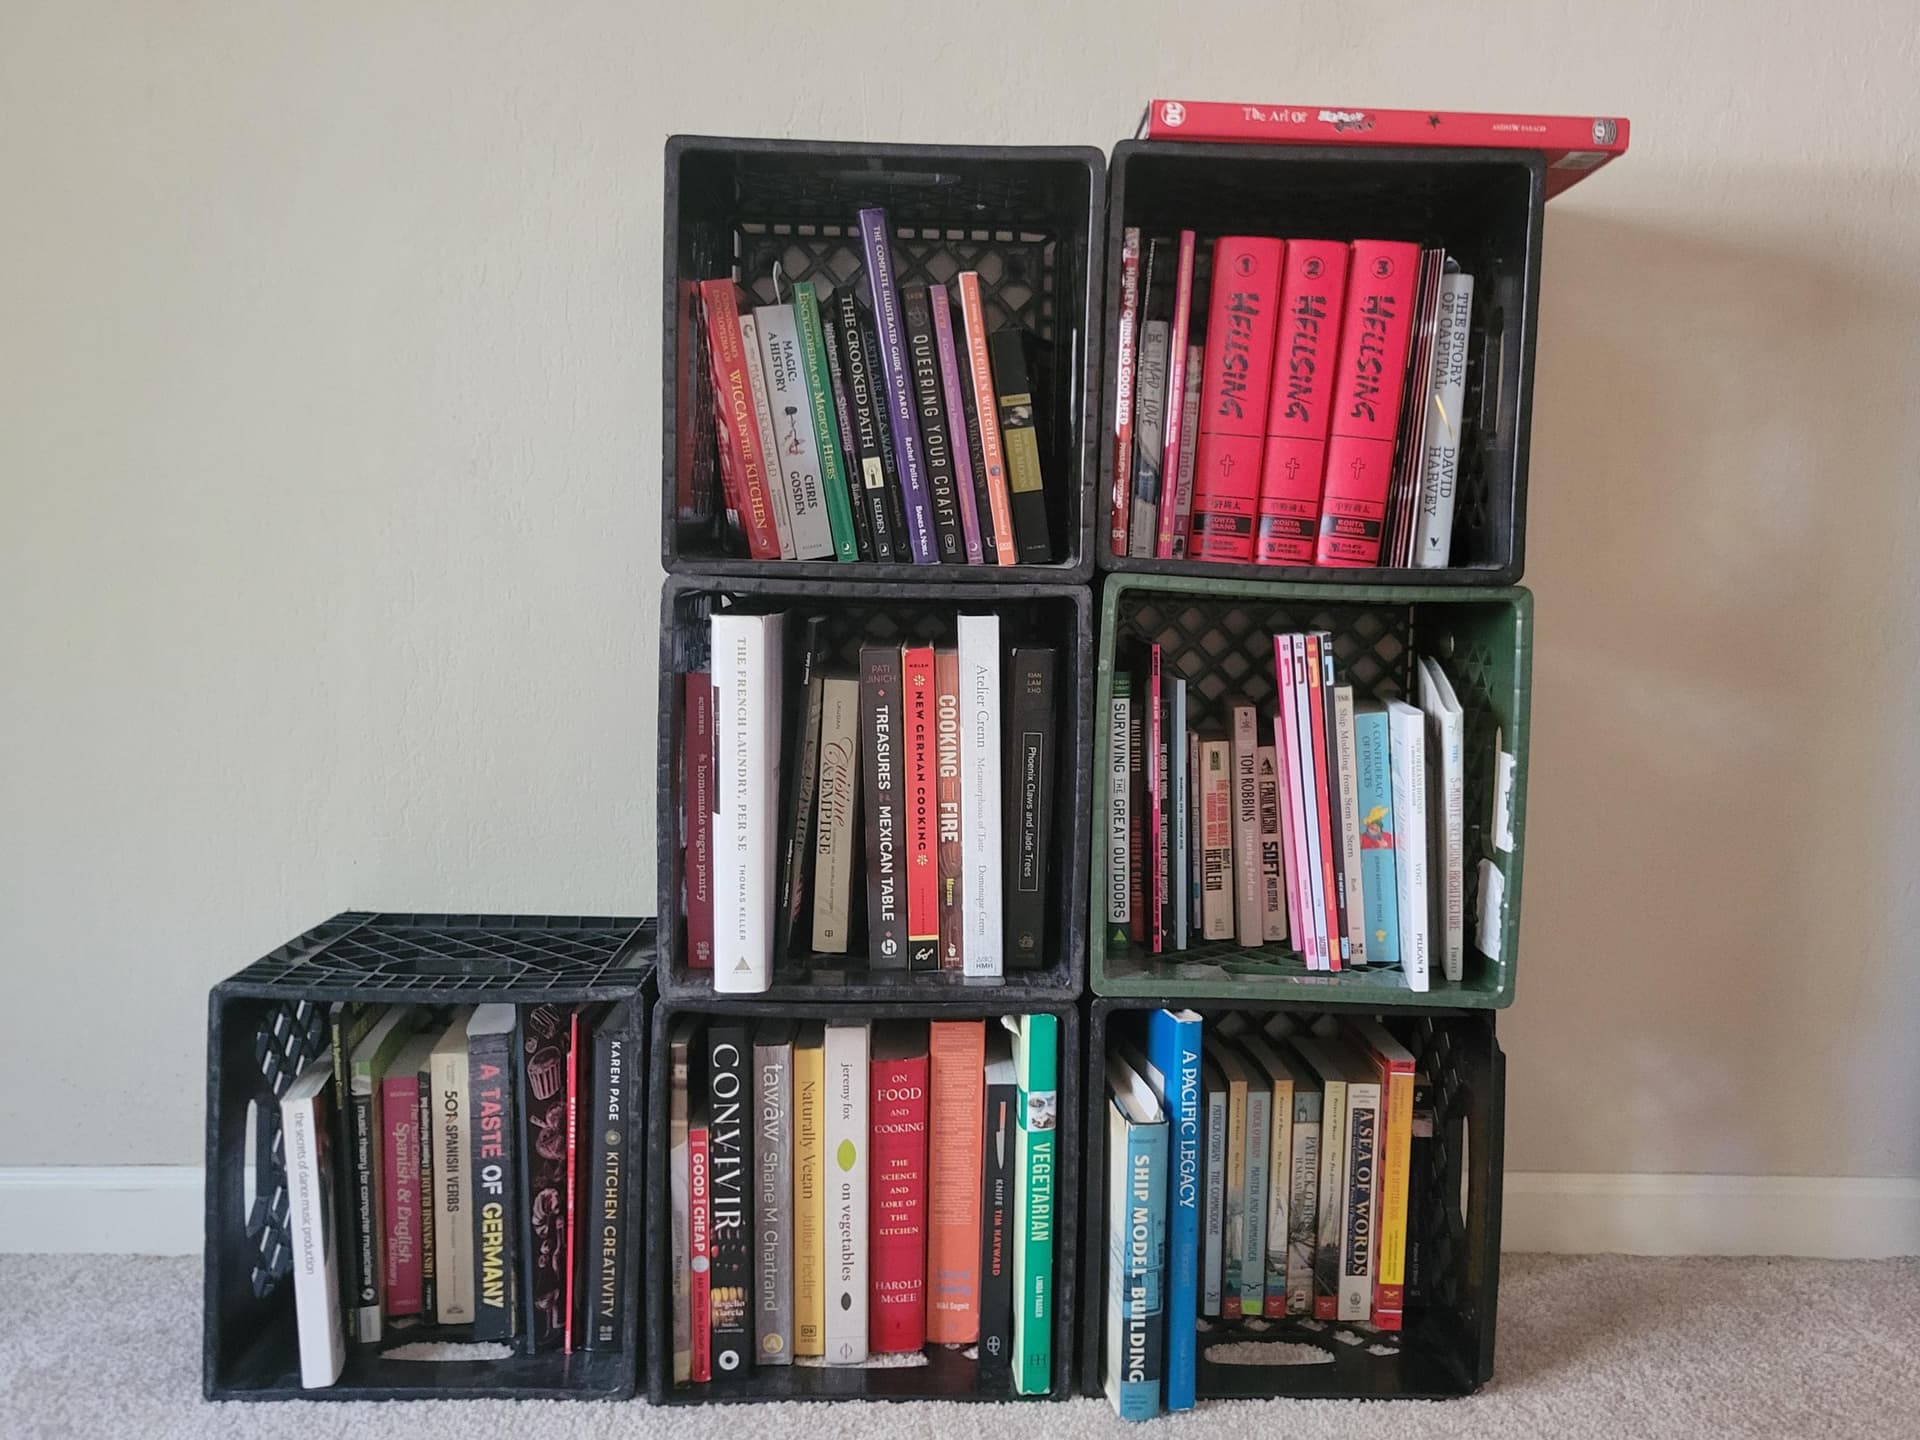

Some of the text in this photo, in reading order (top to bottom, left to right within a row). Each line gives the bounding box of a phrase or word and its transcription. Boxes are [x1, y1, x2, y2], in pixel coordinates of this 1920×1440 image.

[1124, 267, 1136, 308] HARLEY
[1306, 259, 1320, 276] 2
[1376, 259, 1388, 276] 3
[872, 225, 910, 420] THE COMPLETE ILLUSTRATED GUIDE TO TAROT
[1434, 291, 1454, 390] OF CAPITAL
[1450, 293, 1469, 388] THE STORY
[768, 331, 787, 393] A HISTORY
[782, 341, 798, 383] MAGIC:
[841, 293, 876, 449] THE CROOKED PATH
[912, 334, 939, 417] QUEERING
[1121, 349, 1132, 365] NO
[1121, 367, 1131, 398] GOOD
[1219, 293, 1260, 420] HELLSING
[1284, 296, 1327, 424] HELLSING
[1351, 296, 1396, 423] HELLSING
[1120, 399, 1130, 425] DEED
[1142, 360, 1162, 432] MAD LOVE
[729, 368, 767, 530] WICCA IN THE KITCHEN
[927, 424, 948, 468] YOUR
[1184, 401, 1197, 447] Bloom
[1179, 451, 1193, 478] Into
[1425, 446, 1440, 517] HARVEY
[1440, 447, 1456, 499] DAVID
[790, 470, 805, 516] GOSDEN
[804, 473, 817, 509] CHRIS
[873, 497, 886, 534] KELDEN
[933, 475, 955, 526] CRAFT
[1178, 481, 1191, 506] You
[865, 673, 897, 683] JINICH
[871, 663, 890, 673] PATI
[735, 637, 749, 852] THE FRENCH LAUNDRY, PER SE
[915, 690, 927, 851] NEW GERMAN COOKING
[939, 693, 959, 843] COOKING FIRE
[1131, 720, 1141, 772] WALTER TEVIS
[1362, 736, 1374, 788] OF DUNCES
[1373, 721, 1384, 799] A CONFEDERACY
[1240, 752, 1256, 823] TOM ROBBINS
[1338, 707, 1356, 858] Ship Modeling from Stem to Stern
[695, 764, 708, 903] homemade vegan pantry
[875, 704, 895, 921] TREASURES MEXICAN TABLE
[1023, 746, 1037, 877] Phoenix Claws and Jade Trees
[1112, 703, 1126, 919] SURVIVING THE GREAT OUTDOORS
[1204, 848, 1223, 892] HEINLEIN
[738, 864, 747, 941] THOMAS KELLER
[444, 1089, 459, 1120] 501
[609, 1041, 621, 1121] KAREN PAGE
[842, 1062, 854, 1121] jeremy fox
[877, 1087, 922, 1102] FOOD
[891, 1074, 908, 1083] ON
[711, 1043, 742, 1231] CONVIVIR
[874, 1121, 925, 1134] COOKING
[890, 1107, 910, 1116] AND
[1177, 1049, 1198, 1209] A PACIFIC LEGACY
[1360, 1110, 1374, 1120] A
[410, 1103, 420, 1180] The New College
[446, 1125, 459, 1173] SPANISH
[890, 1160, 909, 1168] THE
[1358, 1122, 1374, 1162] SEA
[357, 1105, 373, 1286] music theory for computer musicians
[393, 1121, 413, 1264] Spanish & English
[447, 1175, 459, 1213] VERBS
[480, 1064, 504, 1309] A TASTE OF GERMANY
[693, 1152, 706, 1252] GOOD CHEAP
[762, 1064, 784, 1311] tawâw Shane M. Chartrand
[880, 1172, 918, 1181] SCIENCE
[889, 1186, 909, 1194] AND
[1031, 1142, 1051, 1241] VEGETARIAN
[1356, 1166, 1371, 1193] OF
[880, 1199, 917, 1208] LORE OF
[889, 1213, 909, 1221] THE
[991, 1178, 1003, 1276] KNIFE TIM HAYWARD
[600, 1152, 619, 1318] KITCHEN CREATIVITY
[839, 1182, 855, 1282] on vegetables
[879, 1226, 919, 1236] KITCHEN
[1352, 1199, 1370, 1276] WORDS
[387, 1237, 399, 1287] Dictionary
[875, 1279, 922, 1291] HAROLD
[1128, 1154, 1151, 1385] SHIP MODEL BUILDING
[880, 1293, 918, 1304] McGEE
